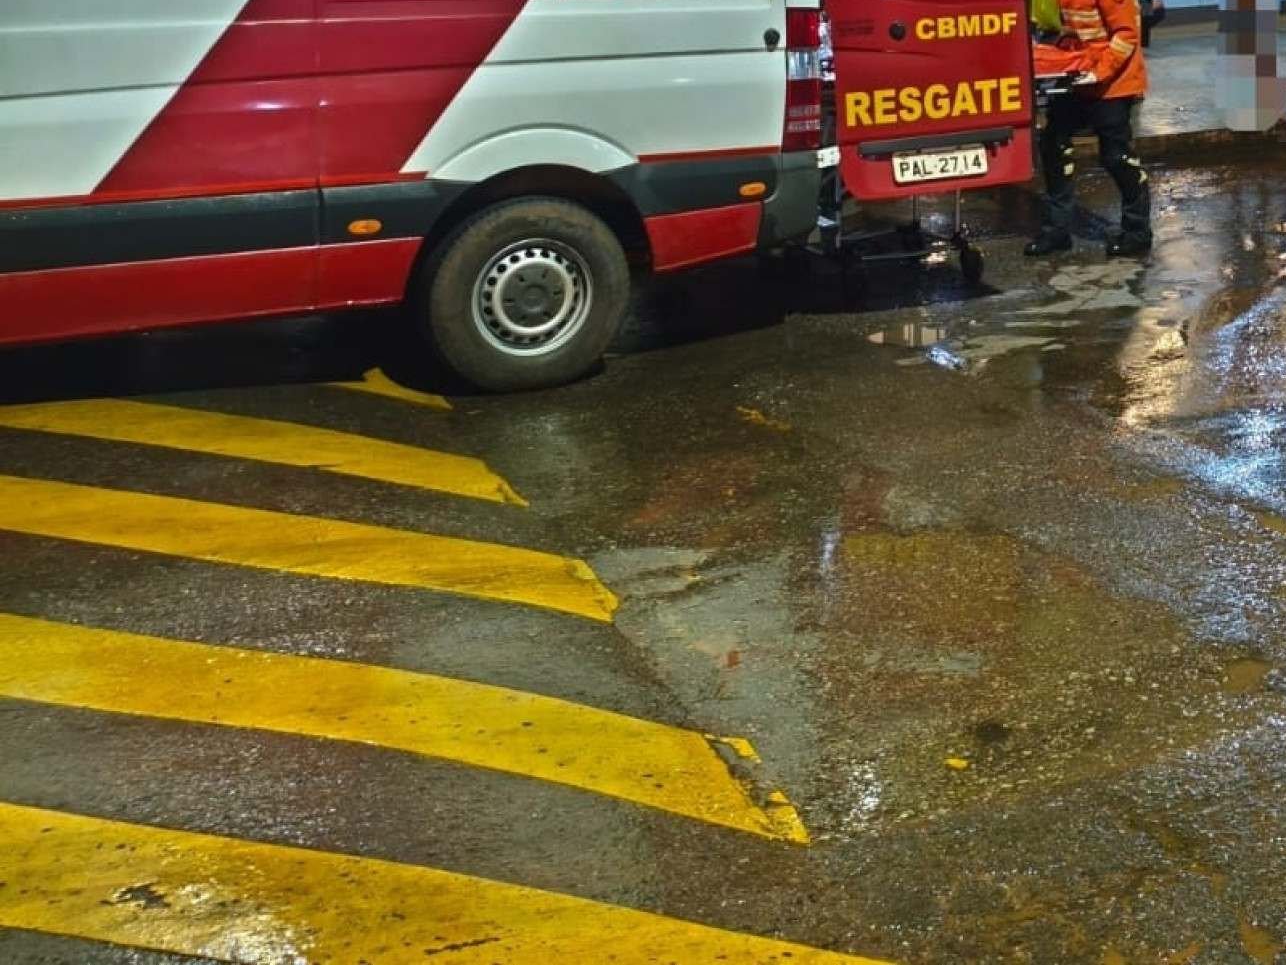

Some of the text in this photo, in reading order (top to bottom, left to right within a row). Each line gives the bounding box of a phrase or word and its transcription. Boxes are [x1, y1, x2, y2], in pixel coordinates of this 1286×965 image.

[915, 13, 1017, 40] CBMDF
[845, 77, 1022, 127] RESGATE
[899, 154, 982, 178] PAL-2714
